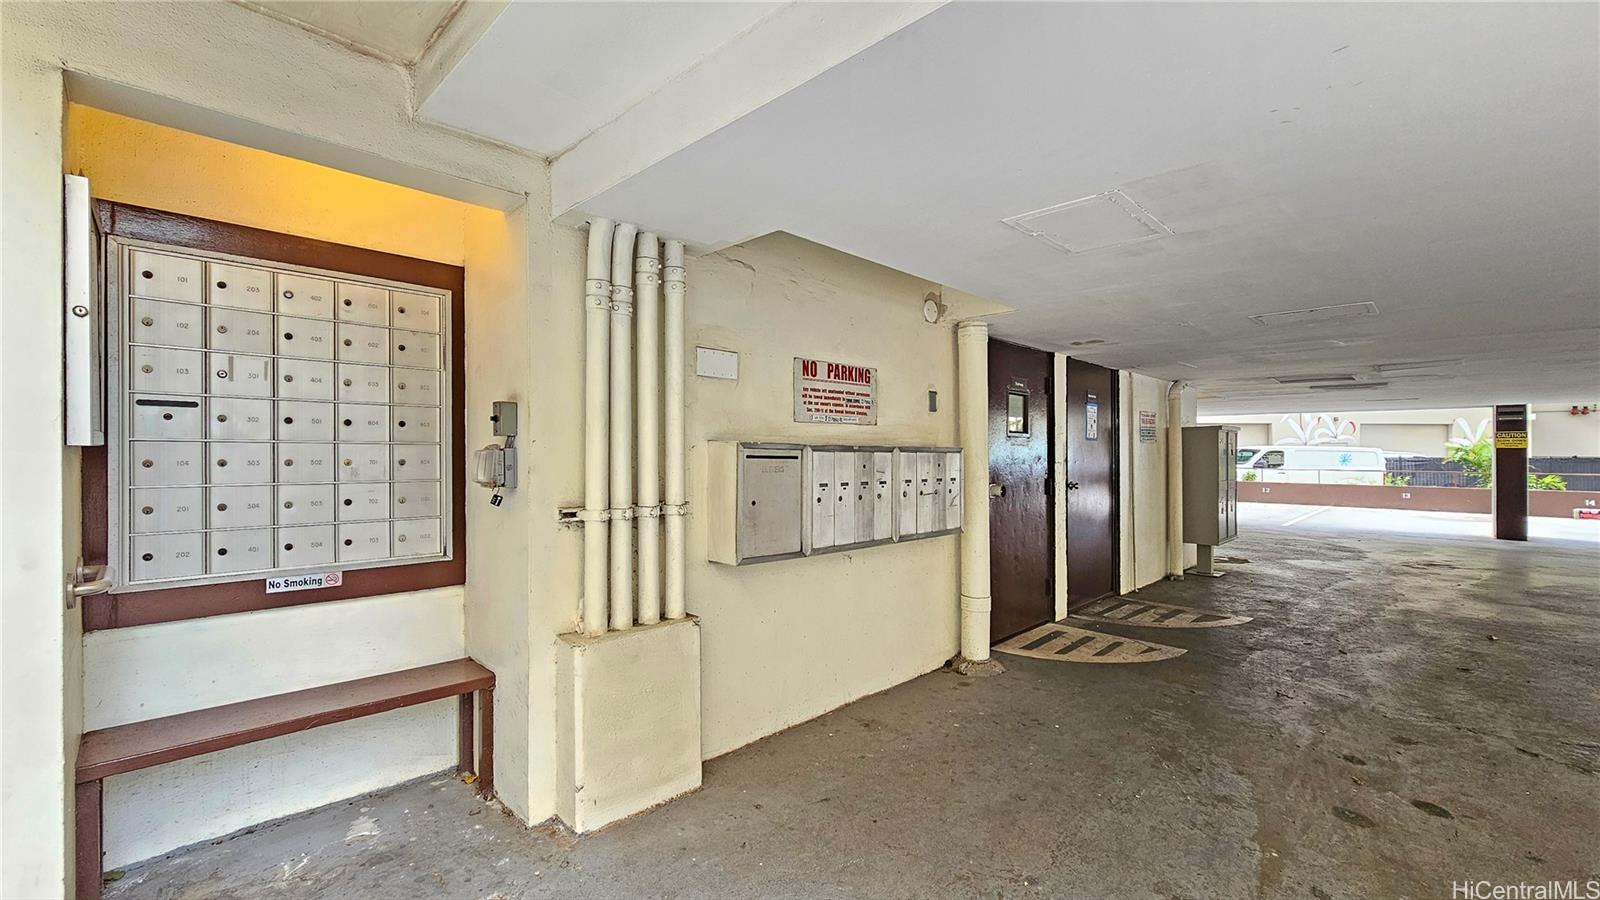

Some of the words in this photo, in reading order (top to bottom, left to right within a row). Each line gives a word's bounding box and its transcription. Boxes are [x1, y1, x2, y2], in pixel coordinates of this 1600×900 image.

[802, 360, 818, 378] NO
[827, 363, 870, 384] PARKING
[268, 580, 281, 590] No
[284, 576, 322, 588] Smoking
